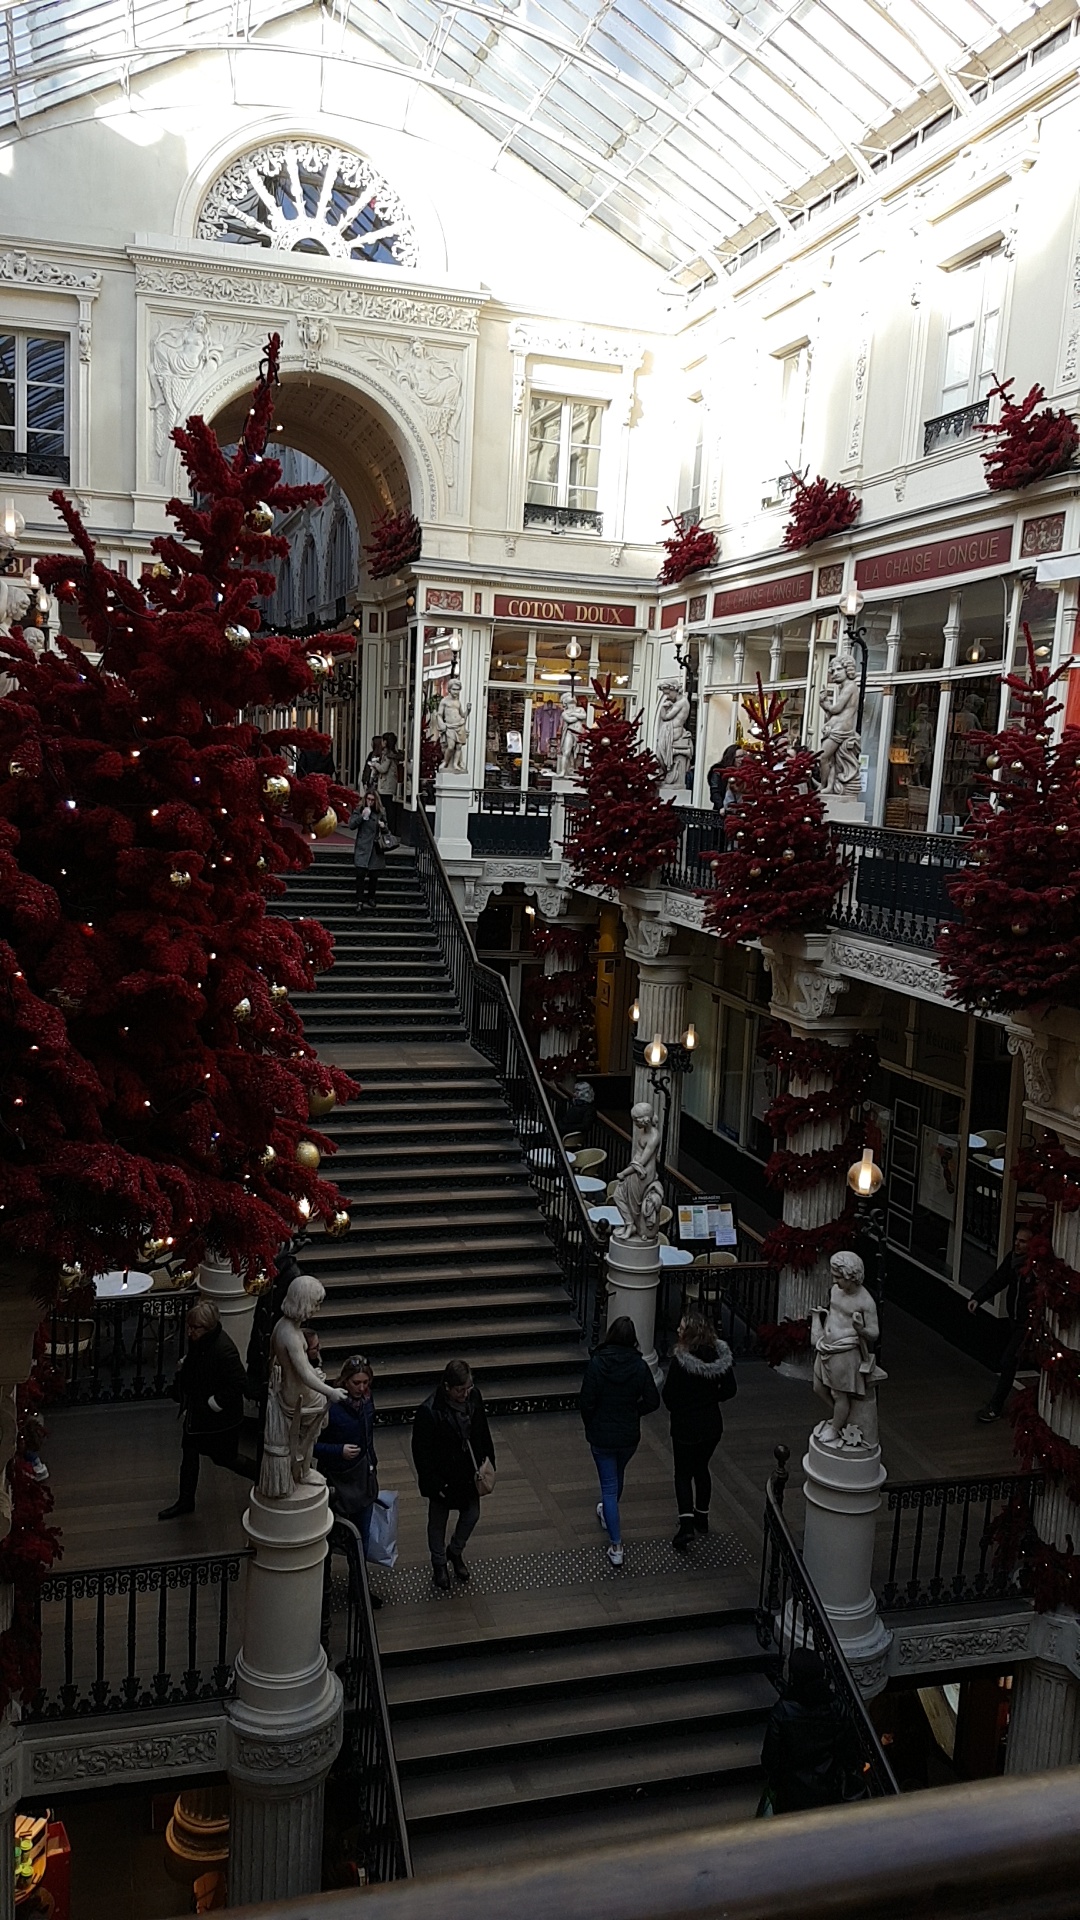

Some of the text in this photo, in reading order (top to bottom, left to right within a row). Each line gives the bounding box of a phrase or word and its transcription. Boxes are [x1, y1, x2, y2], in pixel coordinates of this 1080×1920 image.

[864, 537, 999, 583] LA CHAISE LONGUE
[508, 599, 624, 624] COTON DOUX
[720, 580, 805, 612] LA CHAISE LONGUE
